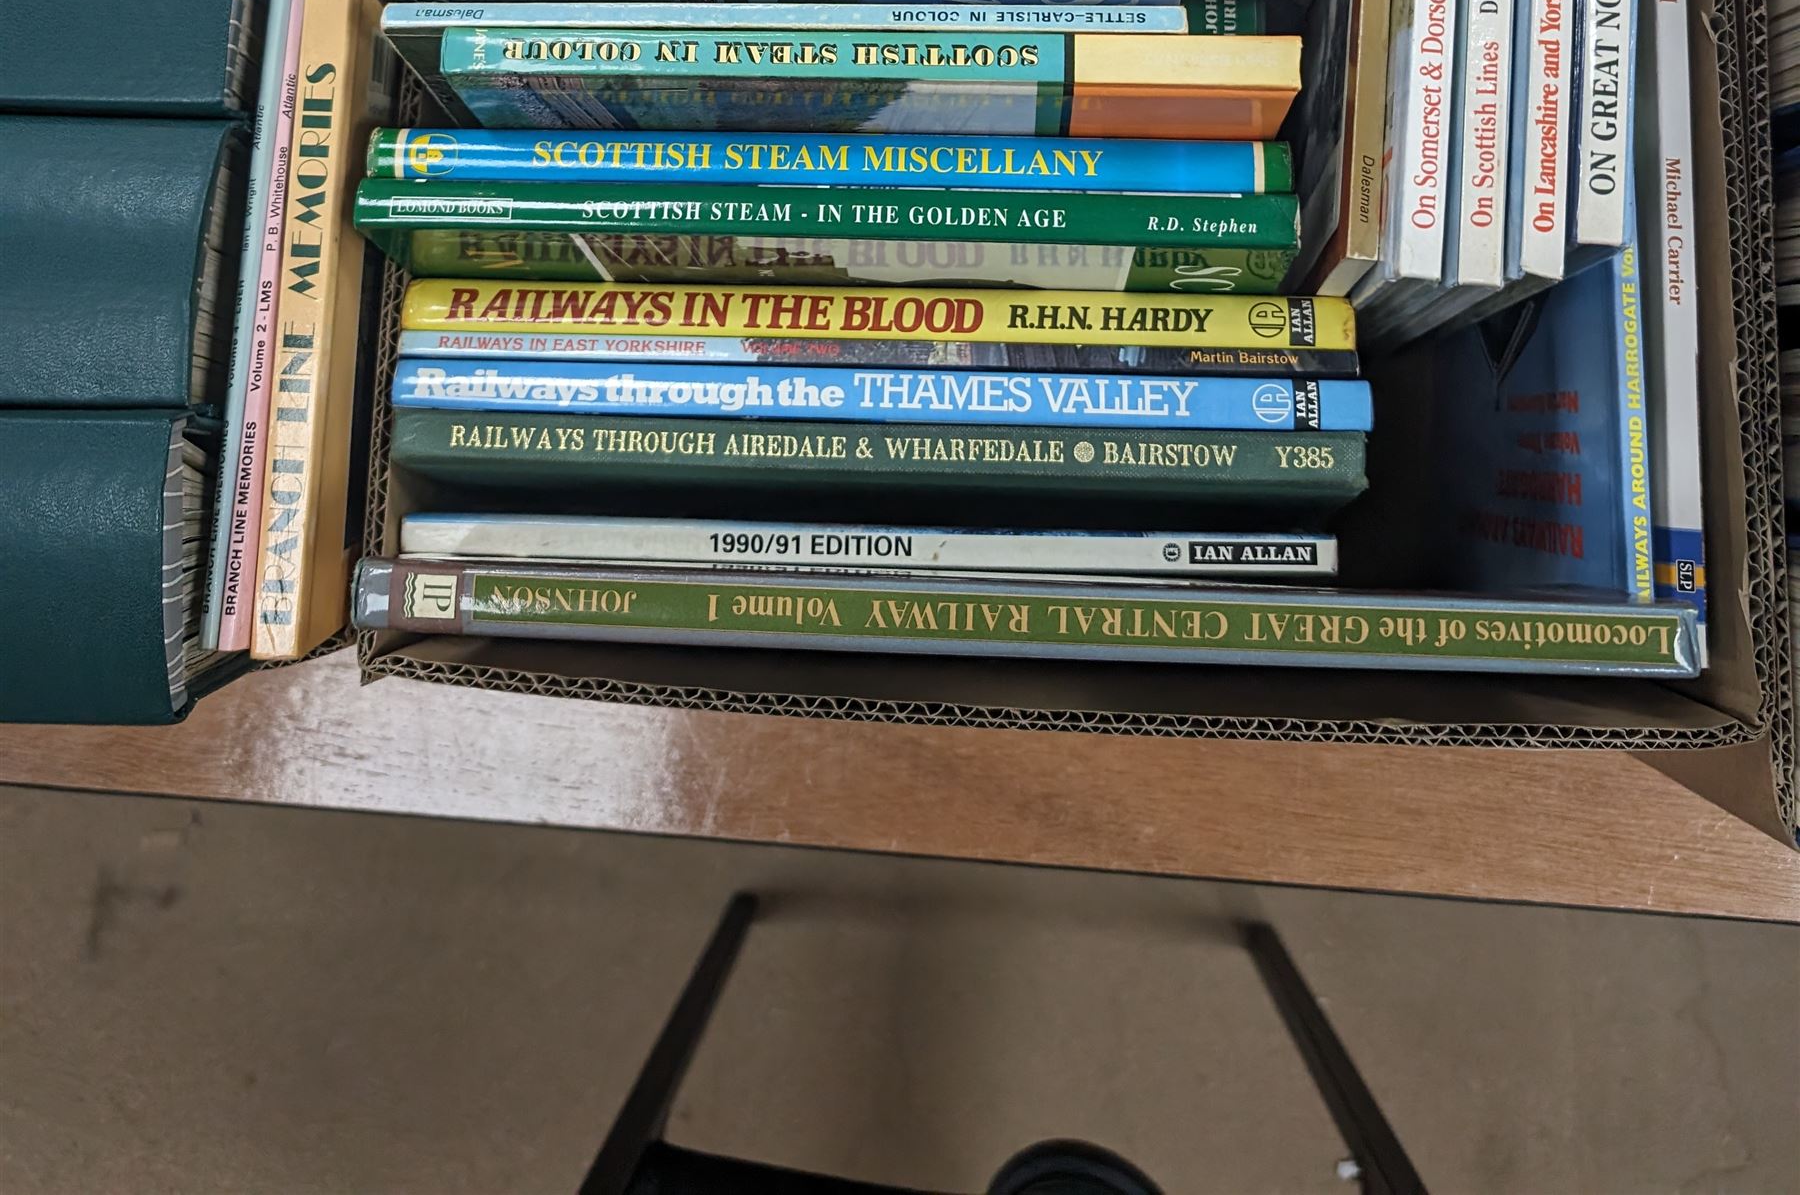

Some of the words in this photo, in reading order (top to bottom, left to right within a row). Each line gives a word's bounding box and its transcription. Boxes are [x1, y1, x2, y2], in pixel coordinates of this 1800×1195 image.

[1420, 62, 1442, 80] &
[1590, 40, 1619, 142] GREAT
[1414, 85, 1441, 188] Somerset
[533, 141, 710, 168] SCOTTISH
[724, 144, 848, 171] STEAM
[864, 147, 1103, 176] MISCELLANY
[1589, 154, 1617, 195] ON
[1665, 157, 1682, 230] Michael
[582, 201, 701, 220] SCOTTISH
[710, 203, 791, 221] STEAM
[818, 205, 842, 222] IN
[852, 205, 899, 224] THE
[909, 206, 1008, 226] GOLDEN
[1017, 208, 1066, 228] AGE
[1147, 217, 1184, 232] R.D.
[1193, 218, 1257, 236] Stephen
[1412, 194, 1436, 229] On
[1667, 233, 1681, 304] Carrier
[446, 289, 674, 326] RAILWAYS
[685, 291, 730, 328] IN
[742, 294, 833, 330] THE
[839, 297, 984, 334] BLOOD
[1008, 304, 1092, 331] R.H.N.
[1100, 306, 1213, 333] HARDY
[413, 368, 599, 404] Railways
[604, 369, 775, 411] through
[777, 377, 844, 407] the
[854, 373, 1032, 411] THAMES
[1039, 378, 1198, 417] VALLEY
[450, 425, 585, 450] RAILWAYS
[594, 430, 716, 455] THROUGH
[724, 433, 846, 458] AIREDALE
[855, 438, 873, 458] &
[885, 438, 1064, 463] WHARFEDALE
[1104, 443, 1238, 467] BAIRSTOW
[1275, 446, 1334, 469] Y385
[710, 533, 801, 554] 1990/91
[811, 536, 912, 556] EDITION
[1194, 546, 1232, 561] IAN
[1240, 546, 1311, 562] ALLAN
[491, 584, 637, 613] JOHNSON
[709, 594, 720, 621] 1
[733, 594, 842, 626] Volume
[865, 600, 1030, 633] RAILWAY
[1049, 607, 1228, 639] CENTRAL
[1244, 612, 1369, 643] GREAT
[1380, 618, 1427, 645] the
[1435, 618, 1466, 646] of
[1477, 620, 1670, 654] Locomotives
